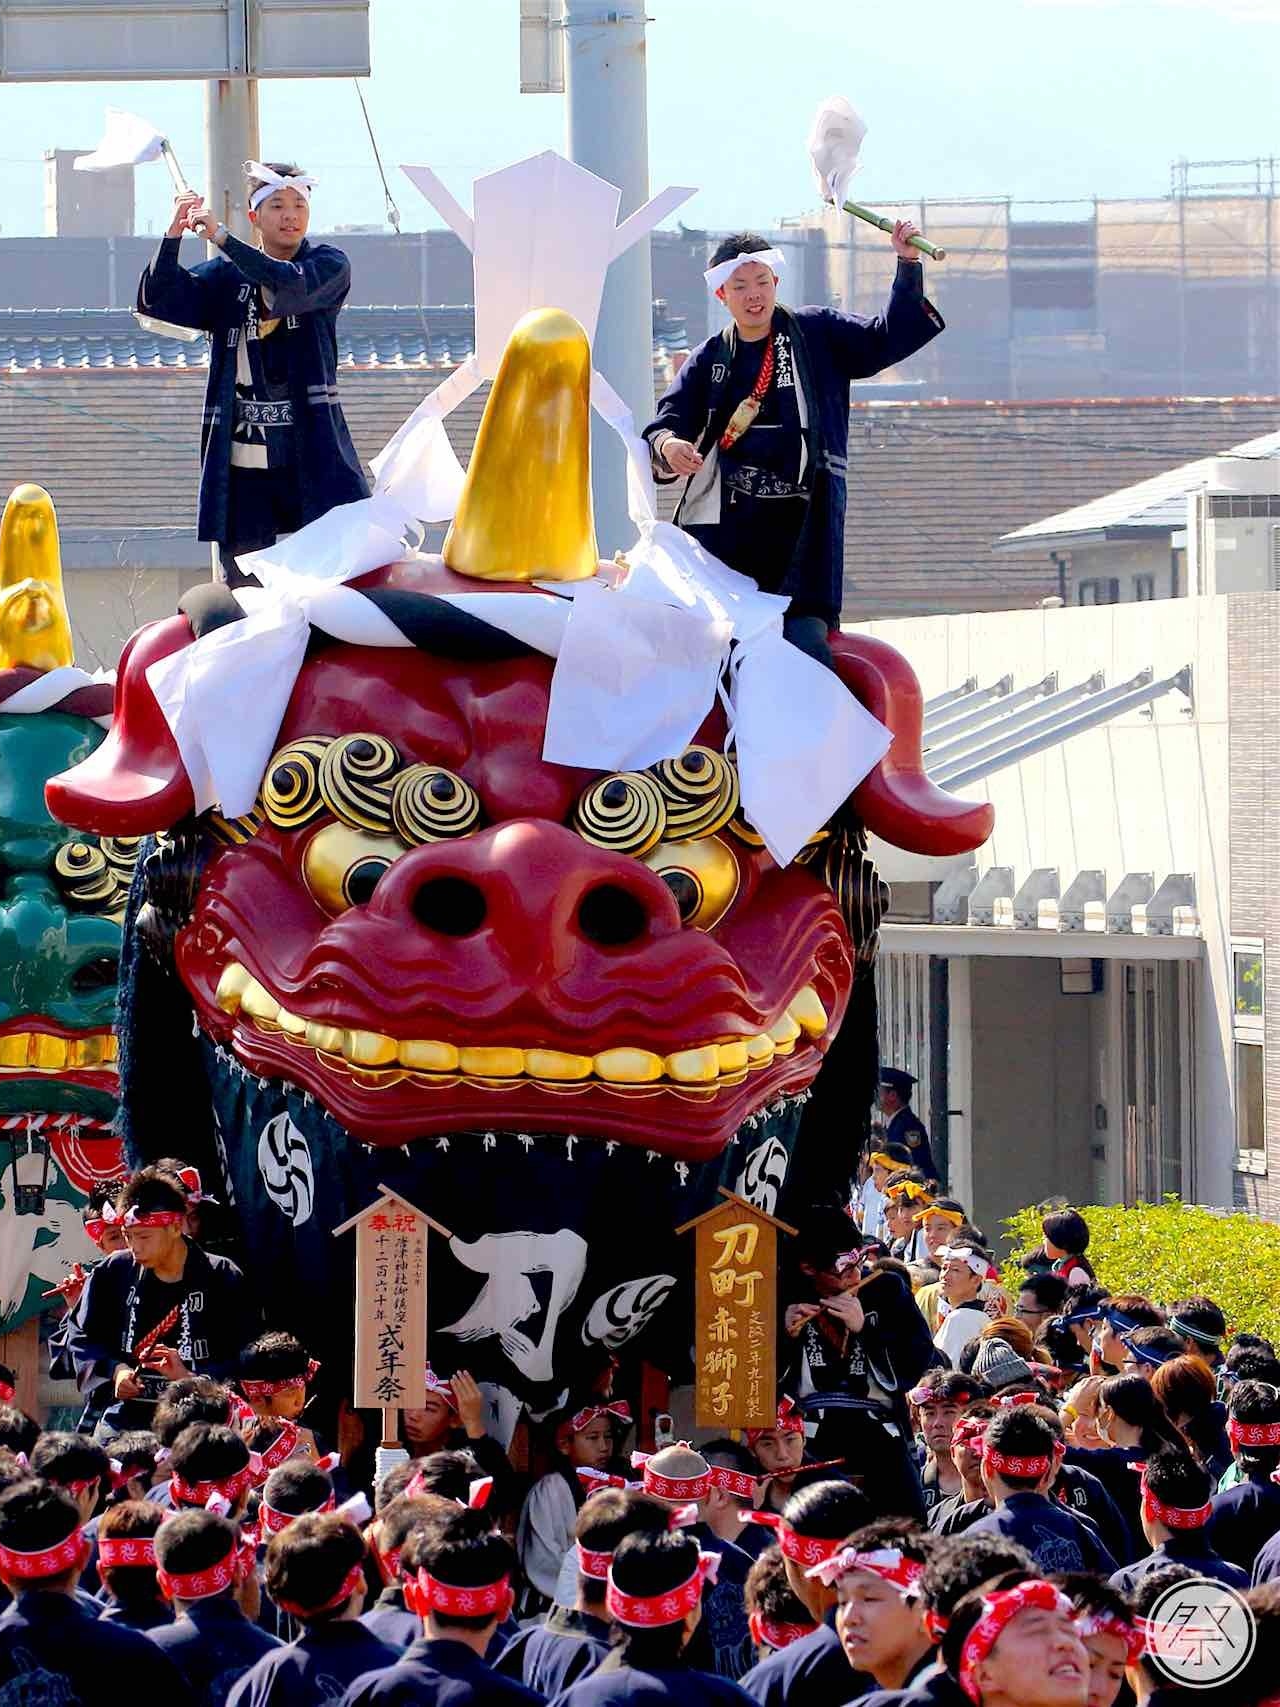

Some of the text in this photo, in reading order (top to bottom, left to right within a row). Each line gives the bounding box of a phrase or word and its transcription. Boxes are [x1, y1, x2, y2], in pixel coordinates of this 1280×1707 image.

[368, 1215, 417, 1232] 奉祝
[709, 1223, 764, 1308] 刀町
[374, 1324, 407, 1402] 式年祭
[703, 1305, 739, 1416] 赤獅子
